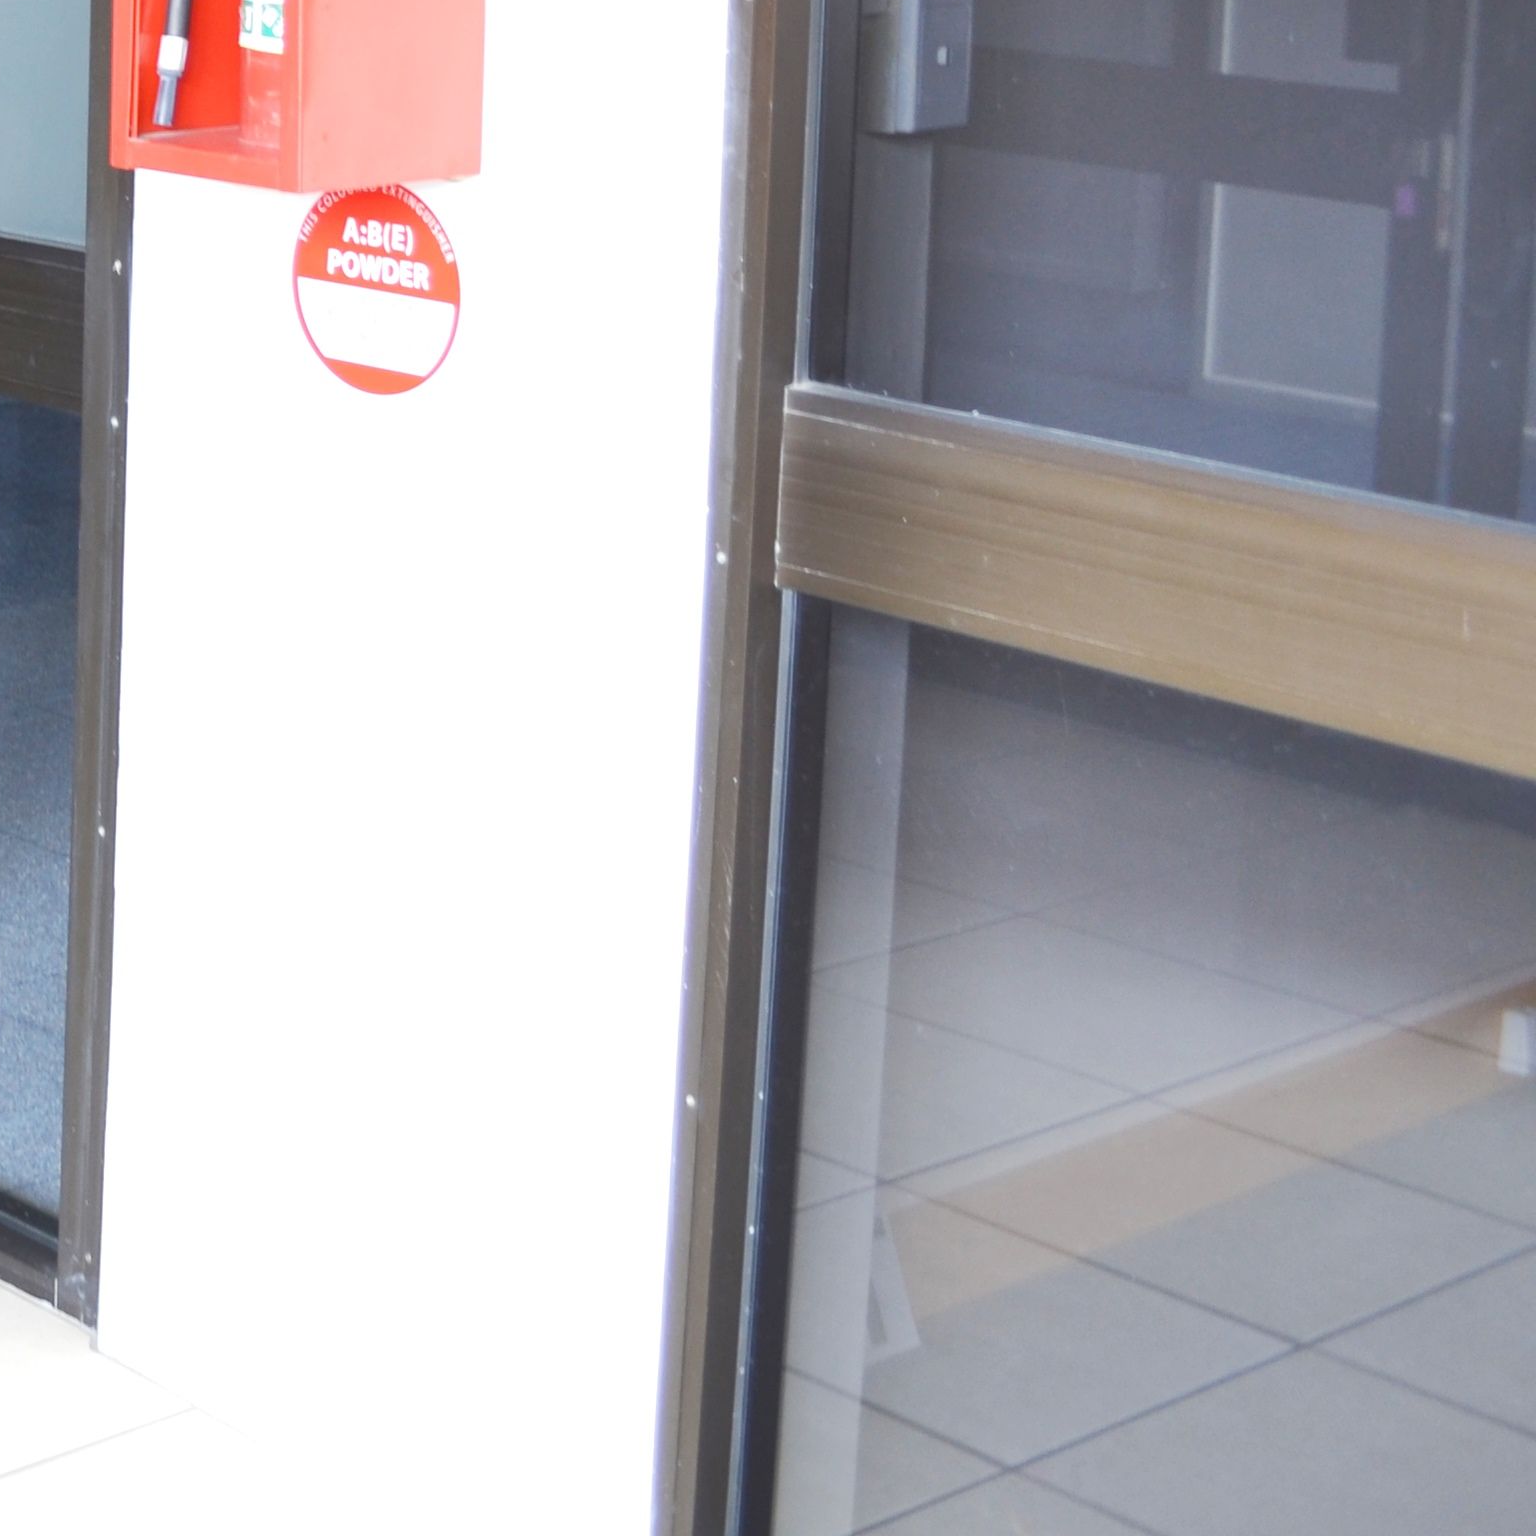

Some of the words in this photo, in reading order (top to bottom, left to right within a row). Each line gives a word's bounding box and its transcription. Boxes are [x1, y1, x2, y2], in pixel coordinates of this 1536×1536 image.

[298, 210, 318, 243] THIS
[381, 184, 456, 264] EXTINGUISHER
[326, 247, 431, 291] POWDER
